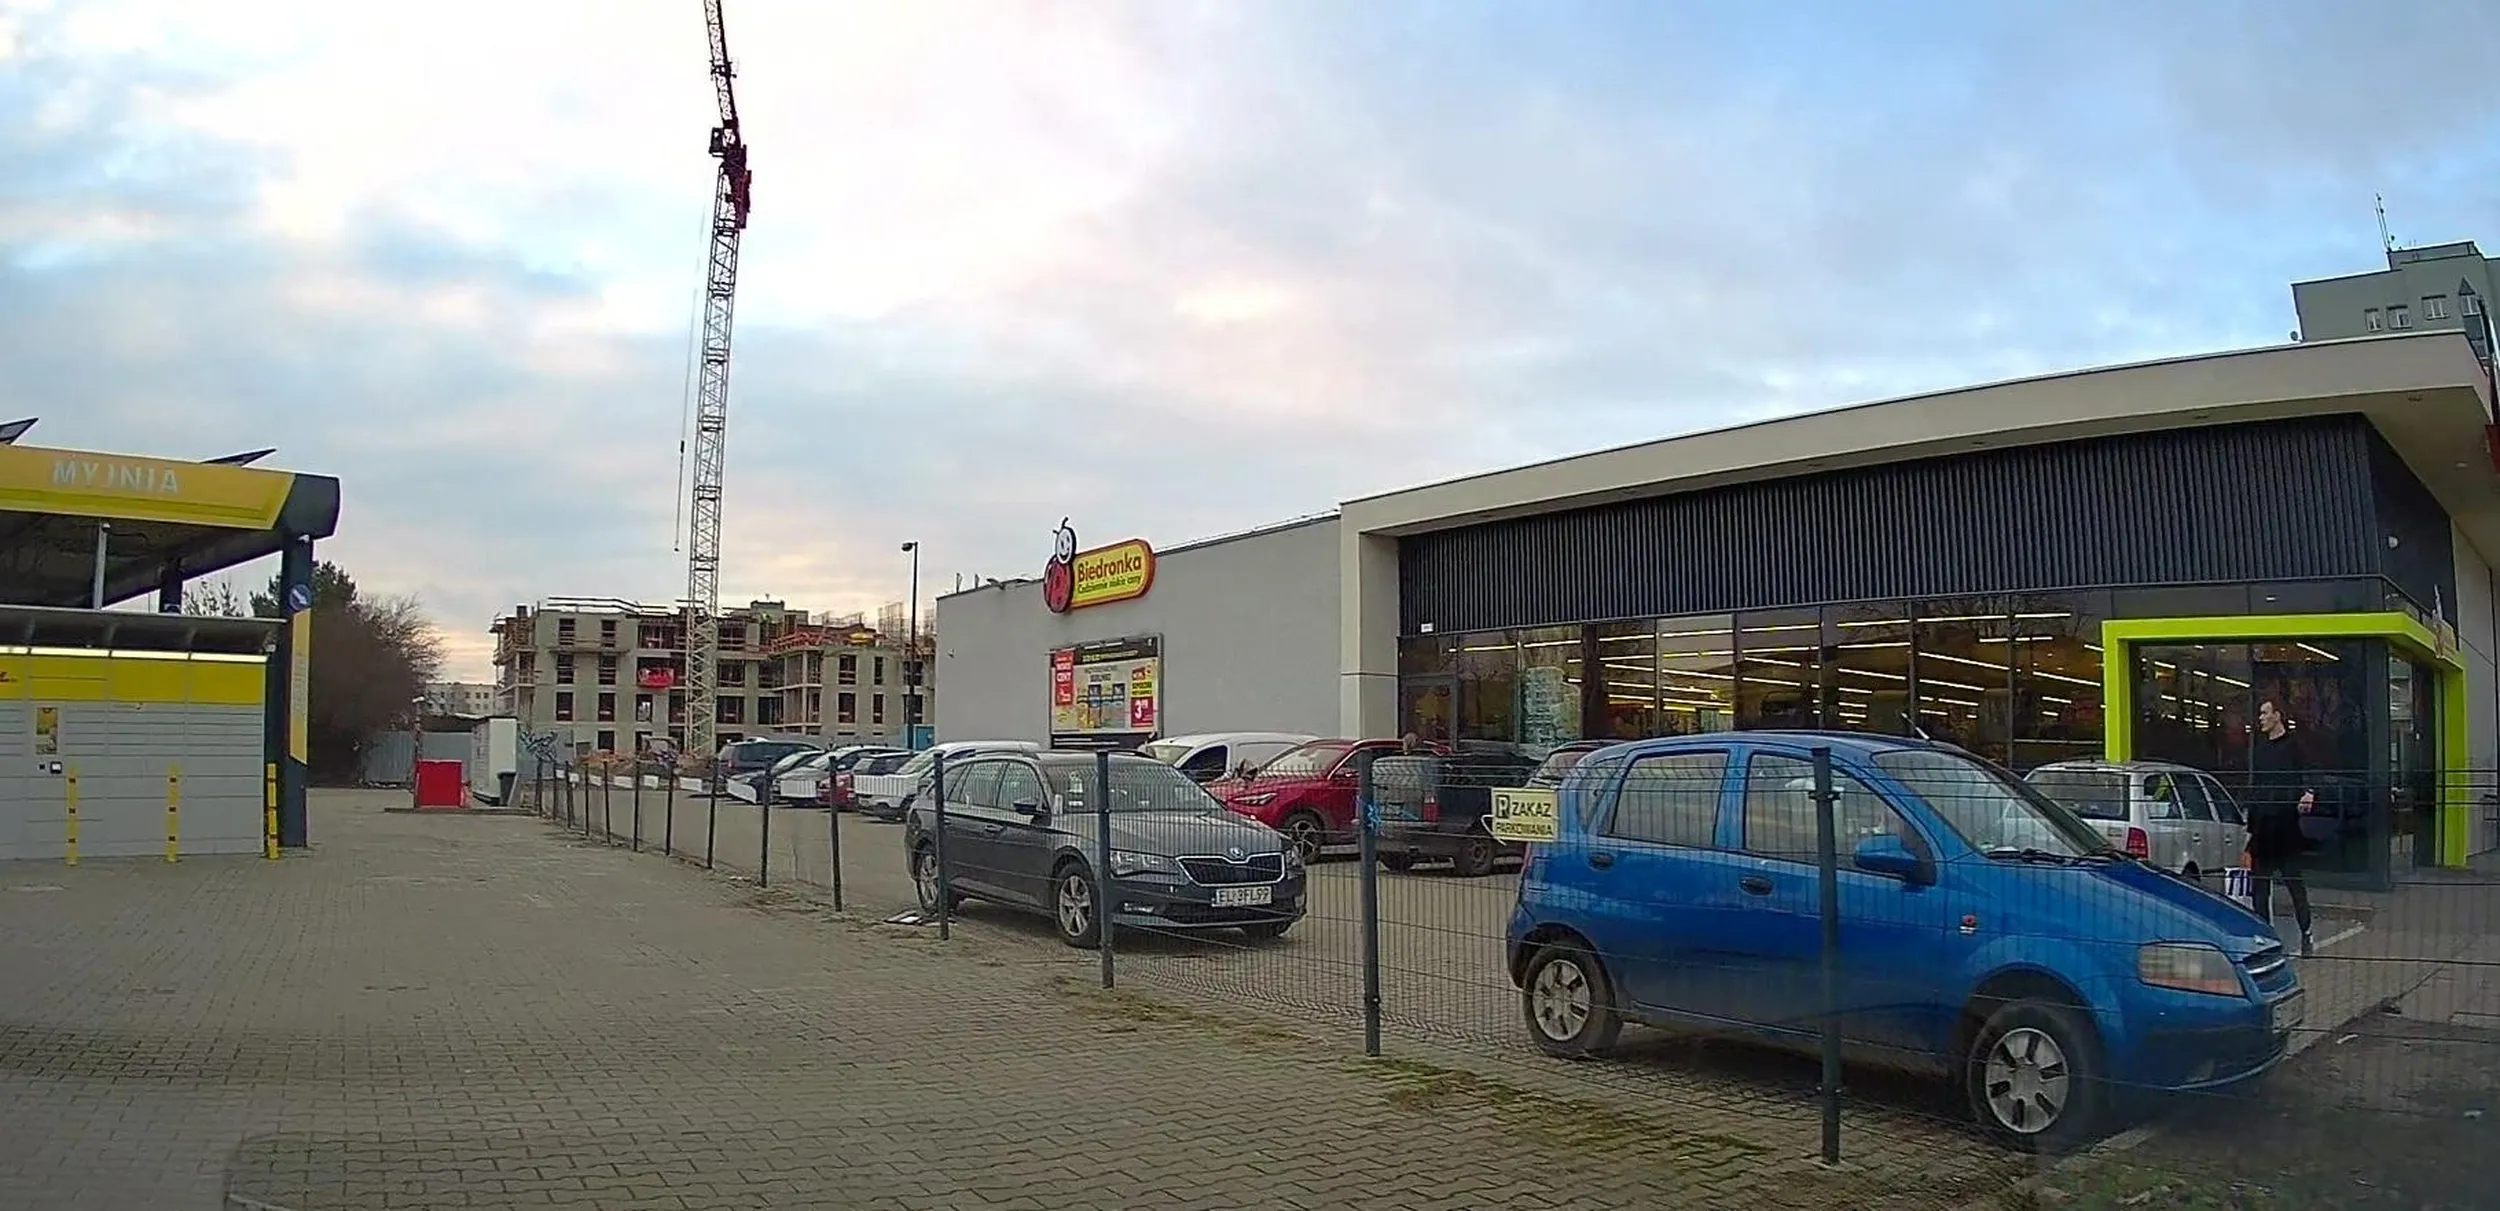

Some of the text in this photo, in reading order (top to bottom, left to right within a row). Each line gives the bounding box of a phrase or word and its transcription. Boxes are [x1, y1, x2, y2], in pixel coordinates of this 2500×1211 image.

[54, 460, 177, 493] MYJNIA
[1078, 552, 1142, 582] Biedronka
[1512, 802, 1552, 817] ZAKAZ
[1219, 890, 1234, 903] EL
